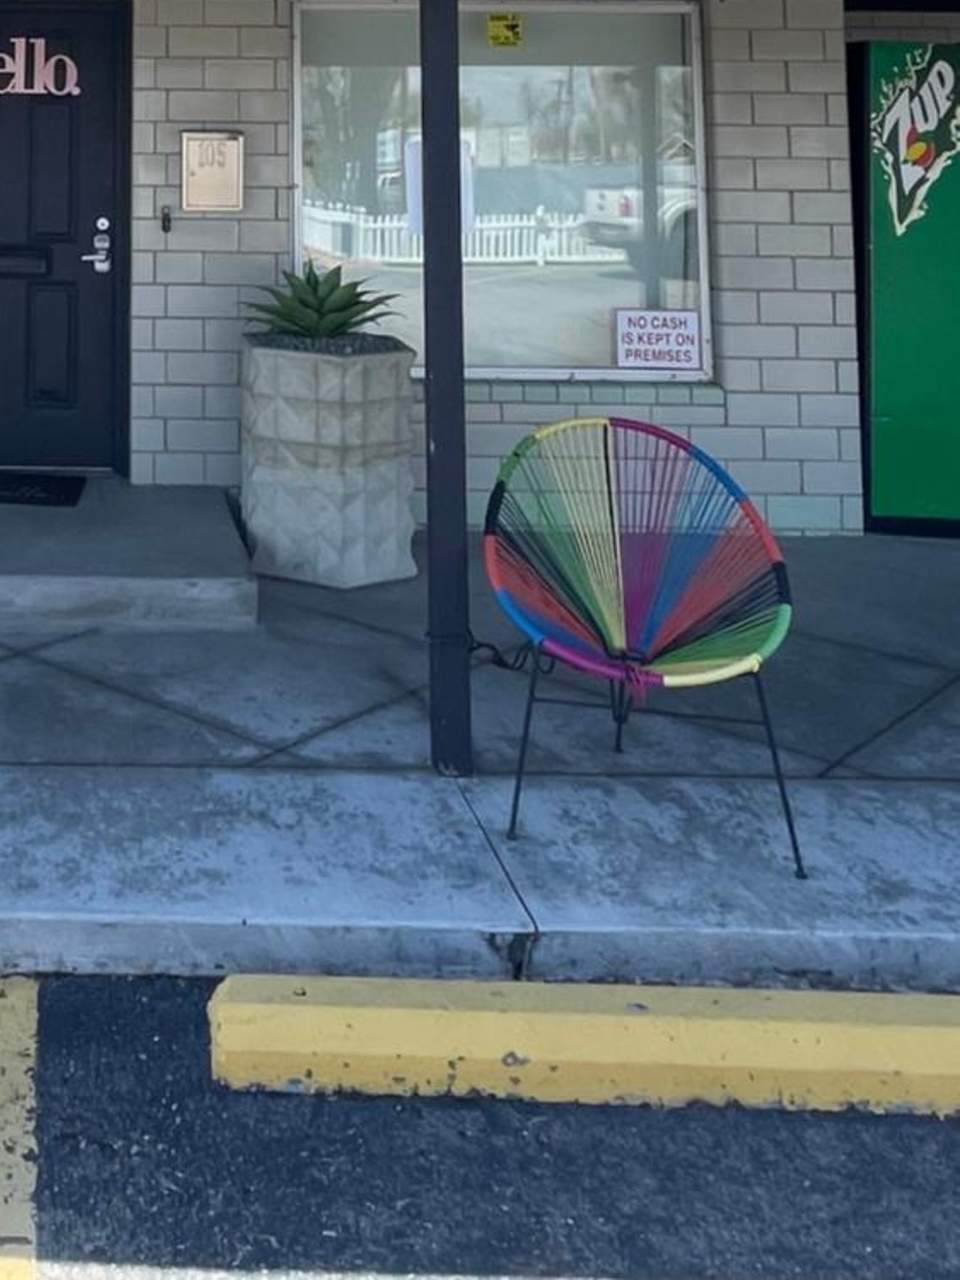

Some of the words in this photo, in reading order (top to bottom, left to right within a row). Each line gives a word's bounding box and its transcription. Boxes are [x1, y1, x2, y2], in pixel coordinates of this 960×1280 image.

[627, 316, 648, 329] NO
[651, 316, 688, 330] CASH
[621, 331, 634, 345] IS
[637, 332, 672, 346] KEPT
[675, 332, 695, 346] ON
[625, 348, 693, 363] PREMISES
